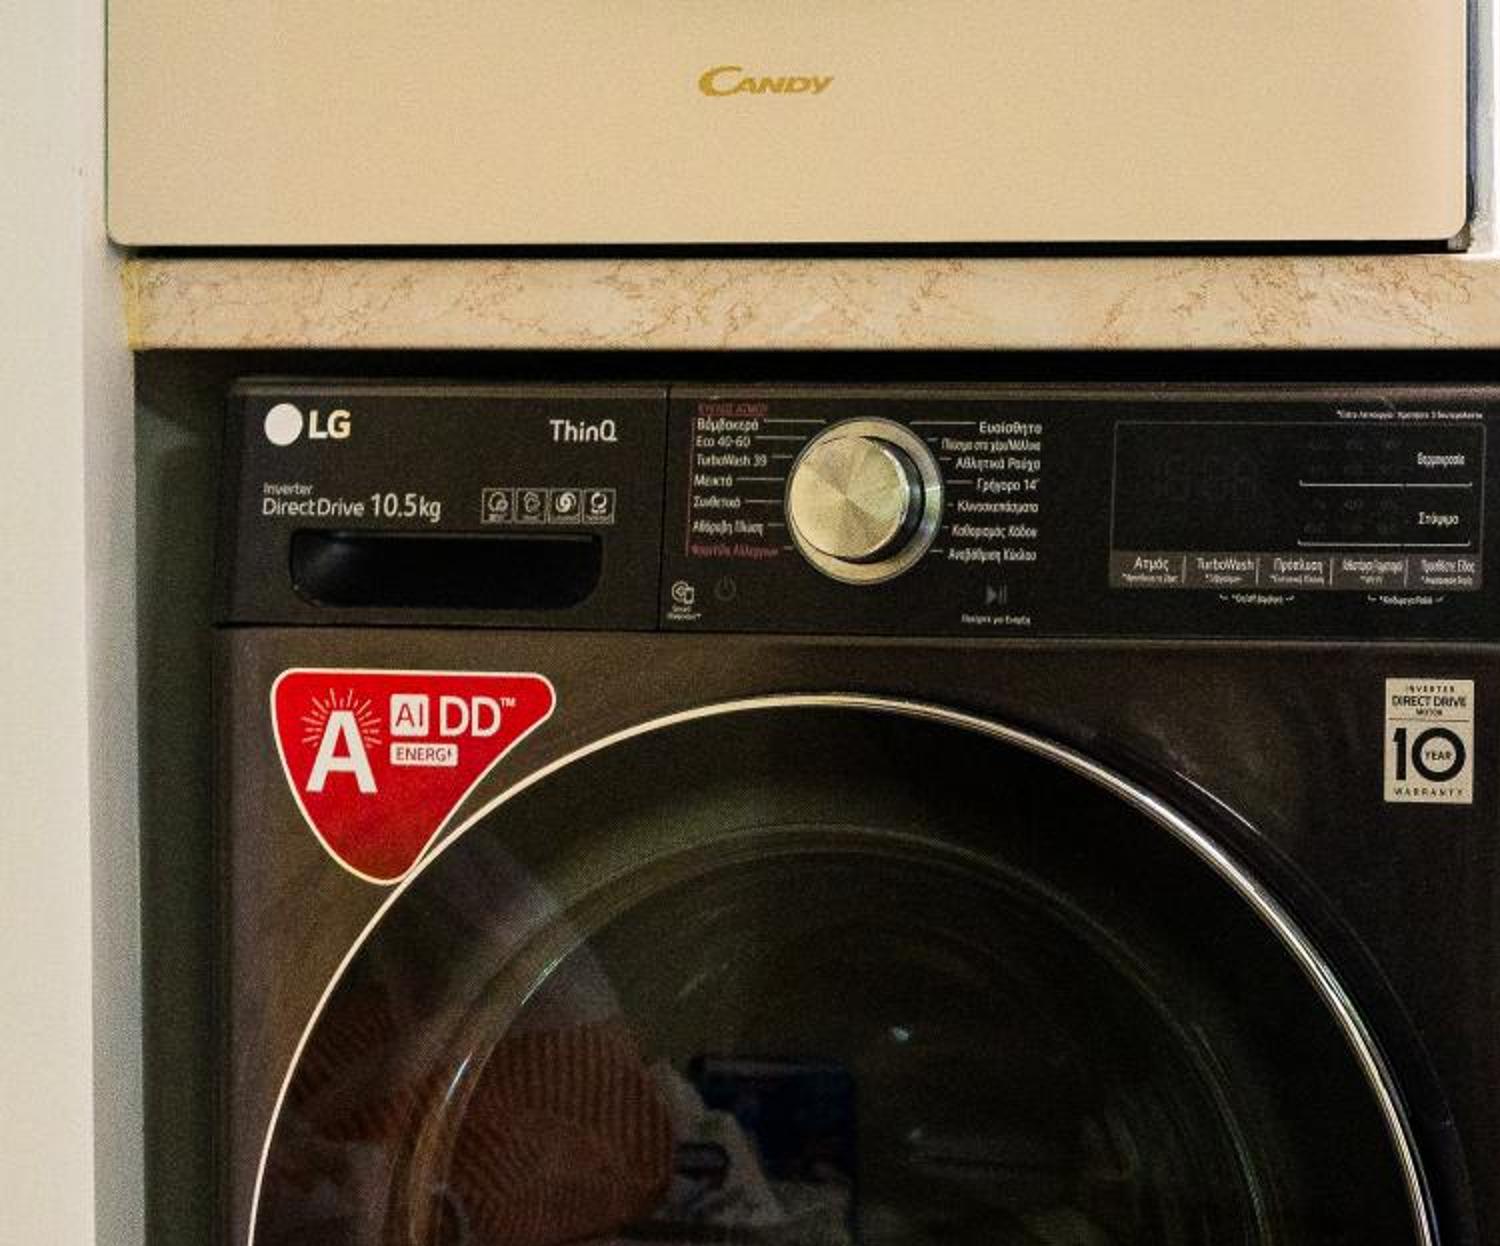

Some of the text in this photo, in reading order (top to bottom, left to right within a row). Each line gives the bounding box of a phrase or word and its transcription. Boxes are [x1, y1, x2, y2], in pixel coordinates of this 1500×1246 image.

[308, 409, 352, 440] LG
[549, 418, 618, 443] ThinQ
[978, 421, 1043, 436] Ευαίσθητα
[717, 435, 751, 448] 40-60
[696, 454, 751, 467] TurboWash
[262, 482, 314, 495] Inverter
[1133, 556, 1169, 571] Ατμός
[1196, 557, 1255, 571] TurboWash
[1391, 695, 1467, 708] DIRECT DRIVE
[394, 702, 424, 728] AI
[305, 709, 379, 794] A
[1393, 727, 1467, 783] 10
[1425, 751, 1452, 761] YEAR
[1394, 788, 1463, 797] WARRANTY
